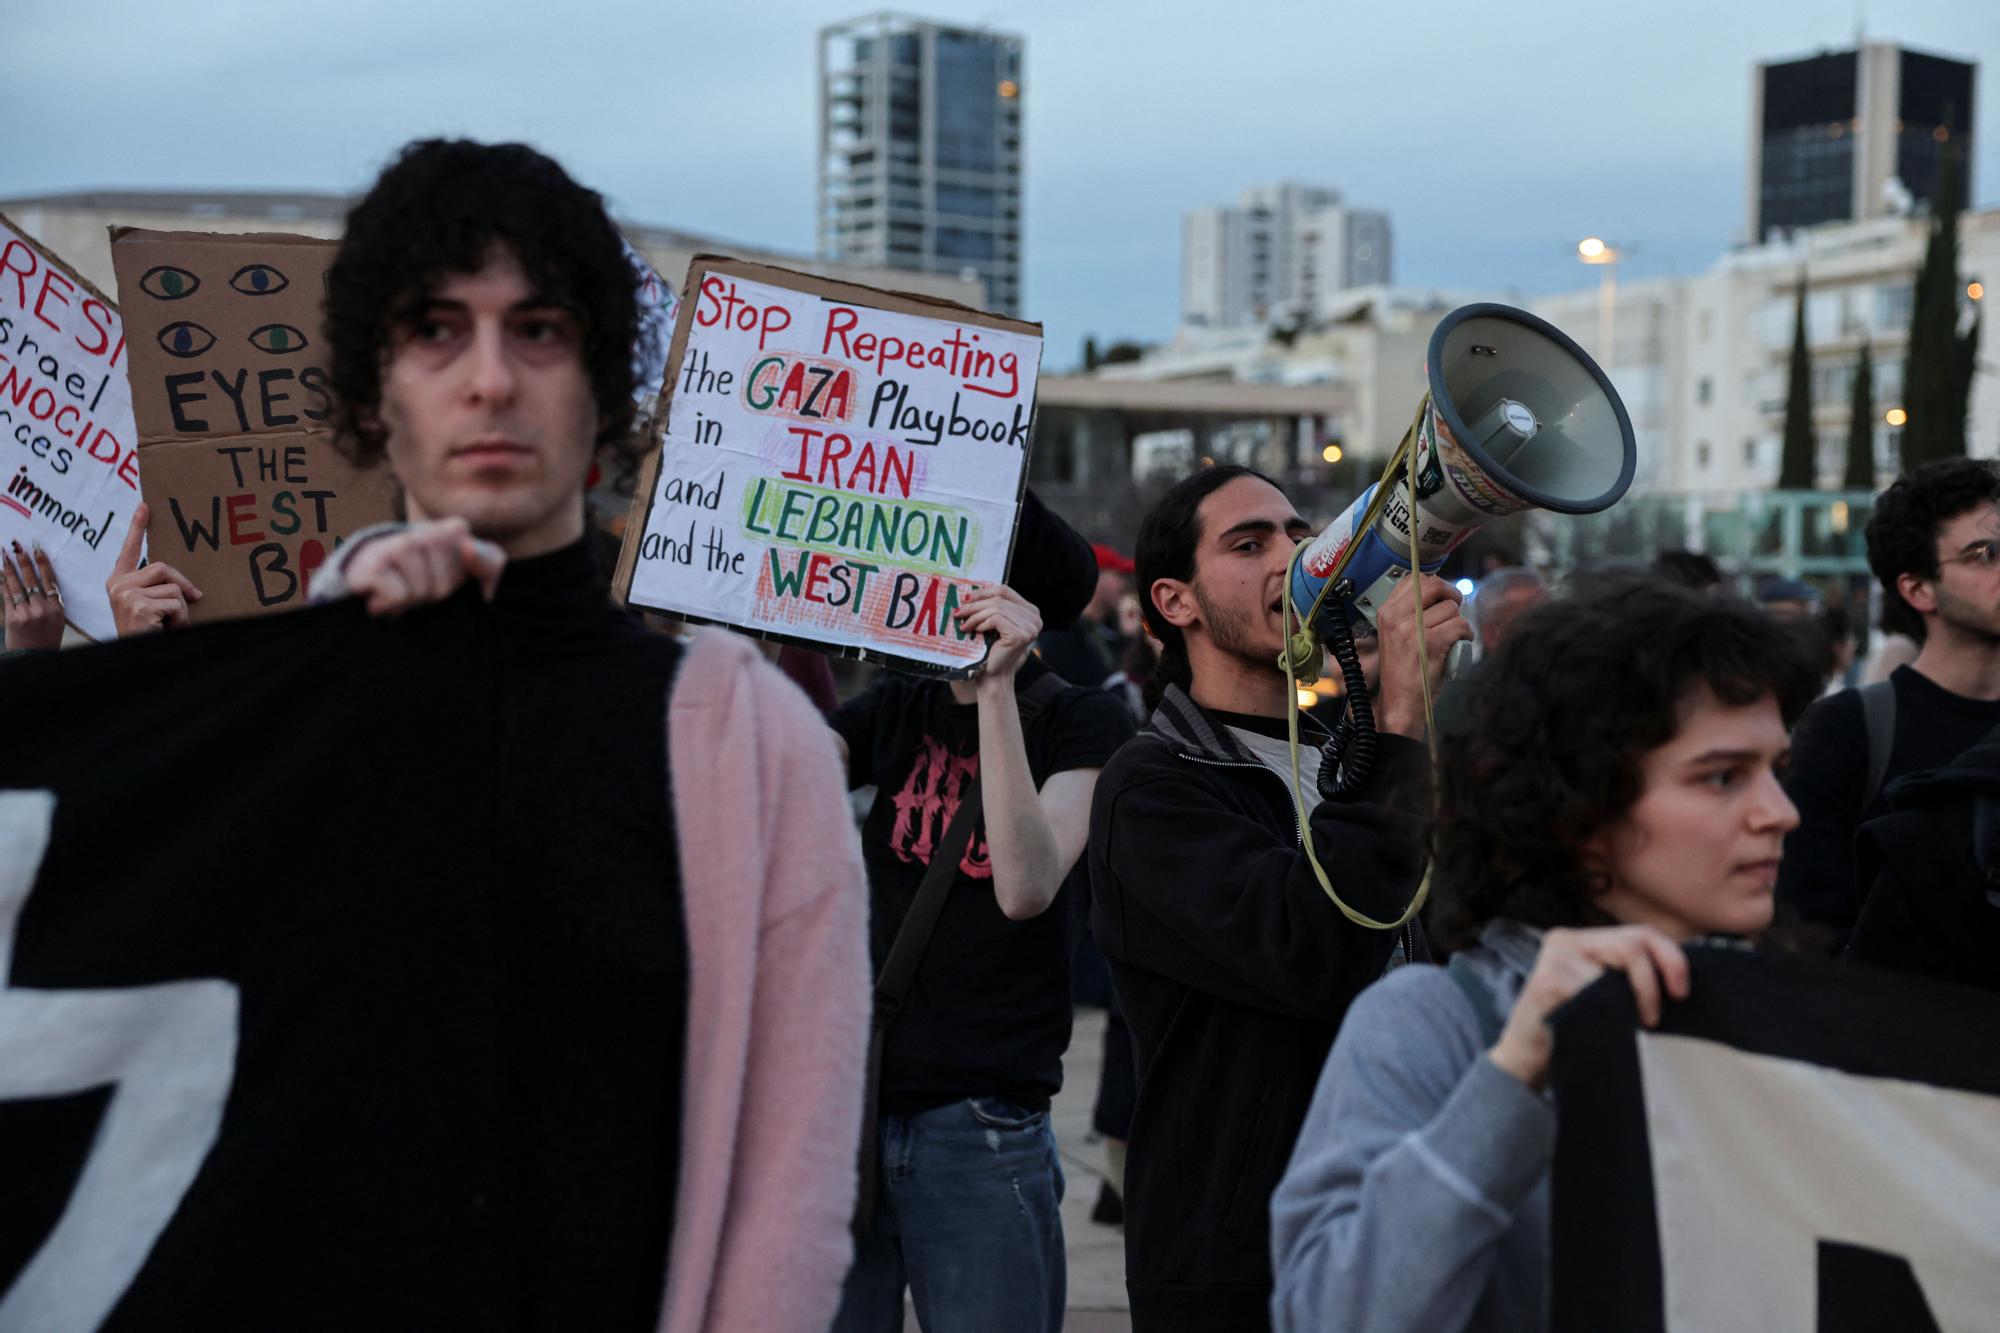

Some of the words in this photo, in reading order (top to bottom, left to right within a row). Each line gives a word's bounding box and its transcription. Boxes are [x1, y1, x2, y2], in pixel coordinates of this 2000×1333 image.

[697, 276, 791, 350] Stop
[822, 308, 1020, 398] Repeating
[0, 353, 139, 491] NOCIDE
[164, 367, 334, 432] EYES
[683, 349, 733, 395] the
[746, 357, 850, 419] GAZA
[868, 380, 1030, 449] Playbook
[694, 412, 723, 446] in
[217, 447, 308, 488] THE
[780, 427, 915, 499] IRAN
[7, 466, 115, 551] immoral
[169, 491, 336, 552] WEST
[665, 472, 725, 511] and
[745, 478, 968, 568] LEBANON
[249, 536, 344, 607] BA
[642, 520, 695, 564] and
[702, 526, 745, 575] the
[769, 546, 879, 614] WEST
[885, 573, 981, 641] BAN
